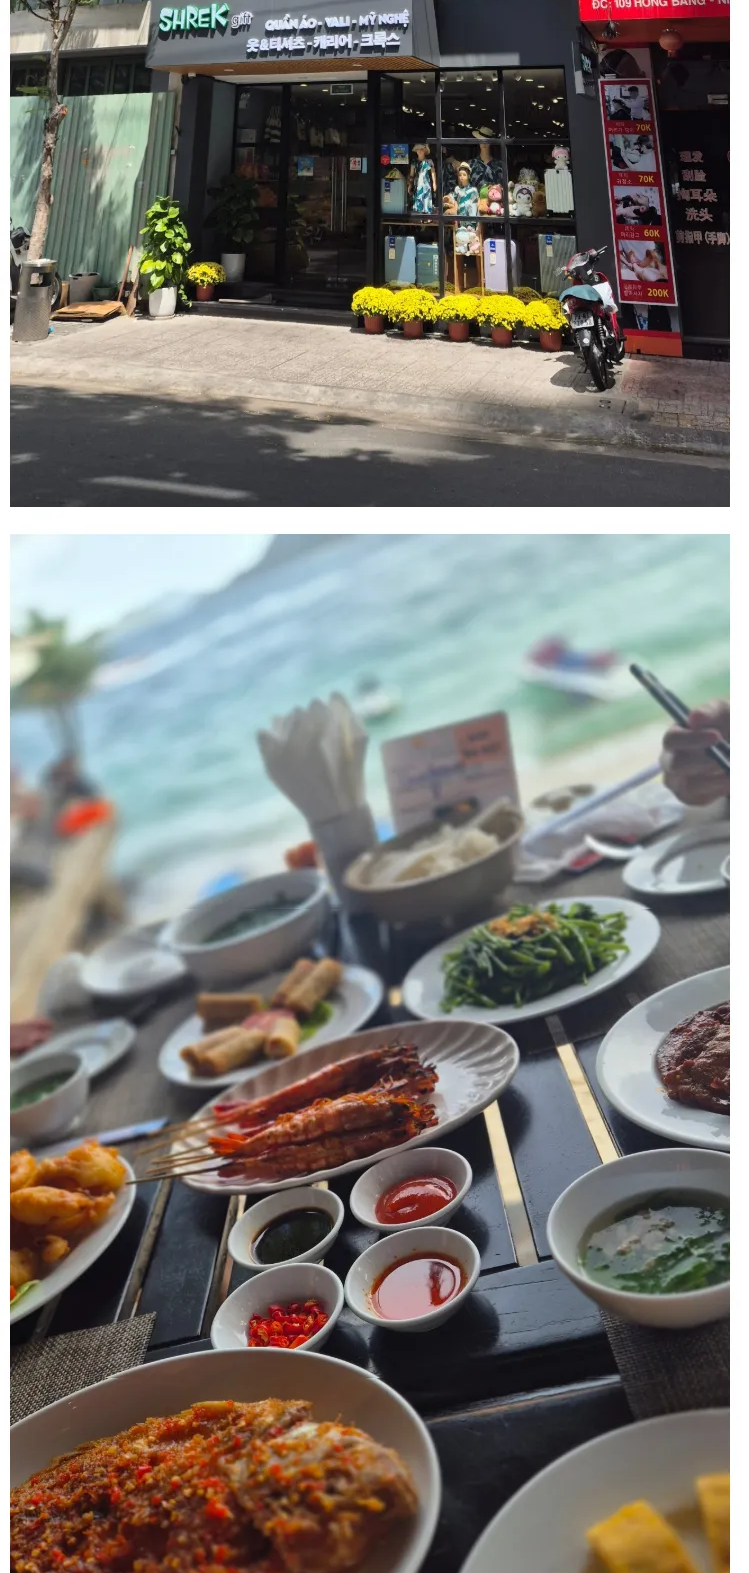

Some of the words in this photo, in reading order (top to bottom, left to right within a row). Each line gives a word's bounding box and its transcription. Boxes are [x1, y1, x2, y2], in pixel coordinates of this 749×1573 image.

[159, 2, 230, 32] SHREK
[231, 11, 253, 29] gift
[324, 15, 350, 29] VALI
[313, 33, 352, 50] 캐리어
[360, 31, 400, 50] 크록스
[635, 123, 652, 132] 70K
[638, 175, 655, 184] 70K
[684, 207, 714, 222] 洗头
[643, 229, 661, 238] 60K
[647, 287, 670, 298] 200K
